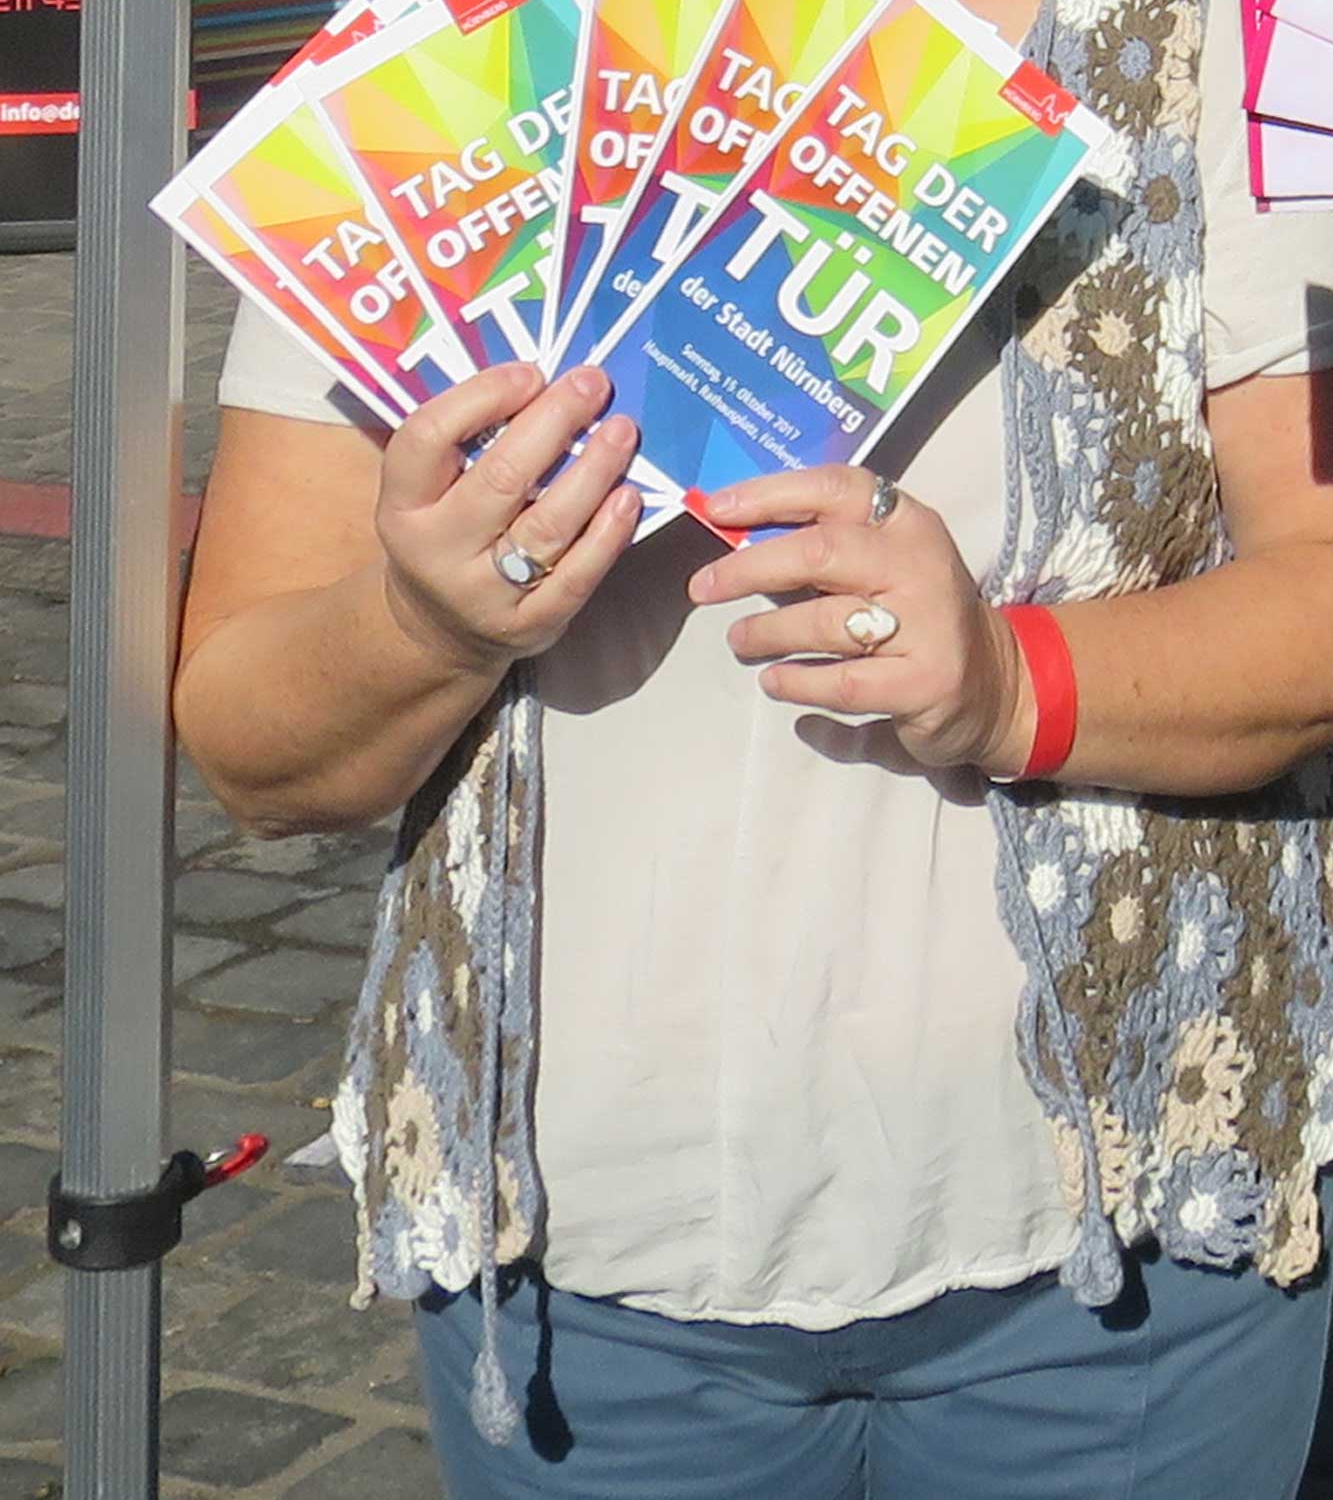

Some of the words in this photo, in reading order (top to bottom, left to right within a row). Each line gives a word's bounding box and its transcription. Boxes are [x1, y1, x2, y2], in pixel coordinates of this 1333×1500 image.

[390, 136, 507, 220] TAG
[506, 84, 574, 157] DE
[789, 134, 977, 298] OFFENEN
[826, 83, 917, 177] TAG
[912, 162, 1009, 254] DER
[680, 276, 720, 312] der
[714, 301, 775, 359] Stadt
[769, 344, 866, 434] Nürnberg
[724, 188, 921, 397] TÜR
